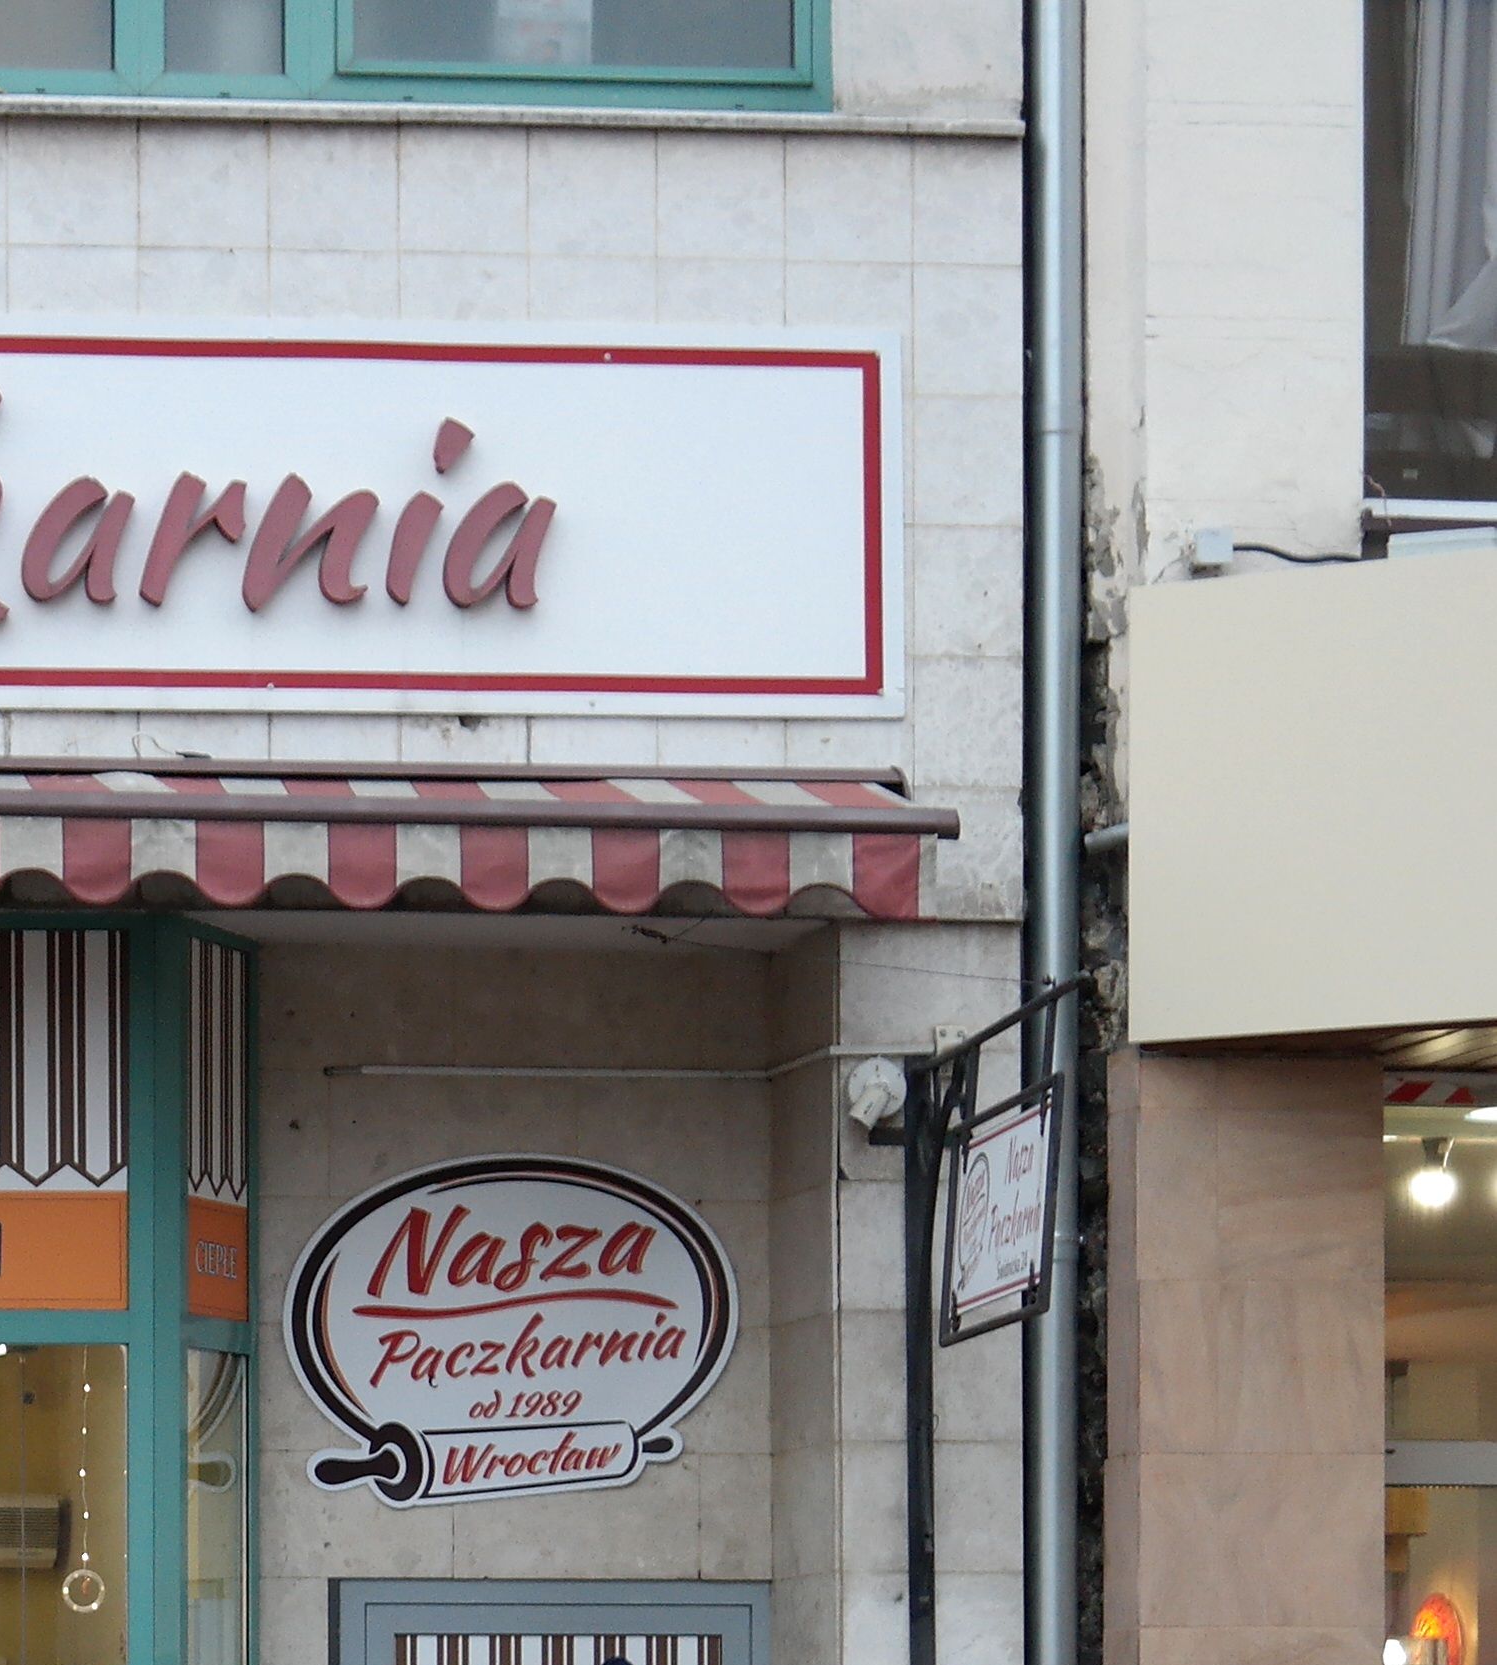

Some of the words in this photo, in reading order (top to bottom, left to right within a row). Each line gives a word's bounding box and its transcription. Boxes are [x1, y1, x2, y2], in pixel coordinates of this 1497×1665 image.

[194, 1239, 238, 1279] CIEPŁE
[366, 1203, 657, 1298] Nasza
[369, 1312, 687, 1389] Pączkarnia
[468, 1389, 504, 1419] od
[504, 1389, 583, 1418] 1989
[442, 1430, 622, 1485] Wrocław
